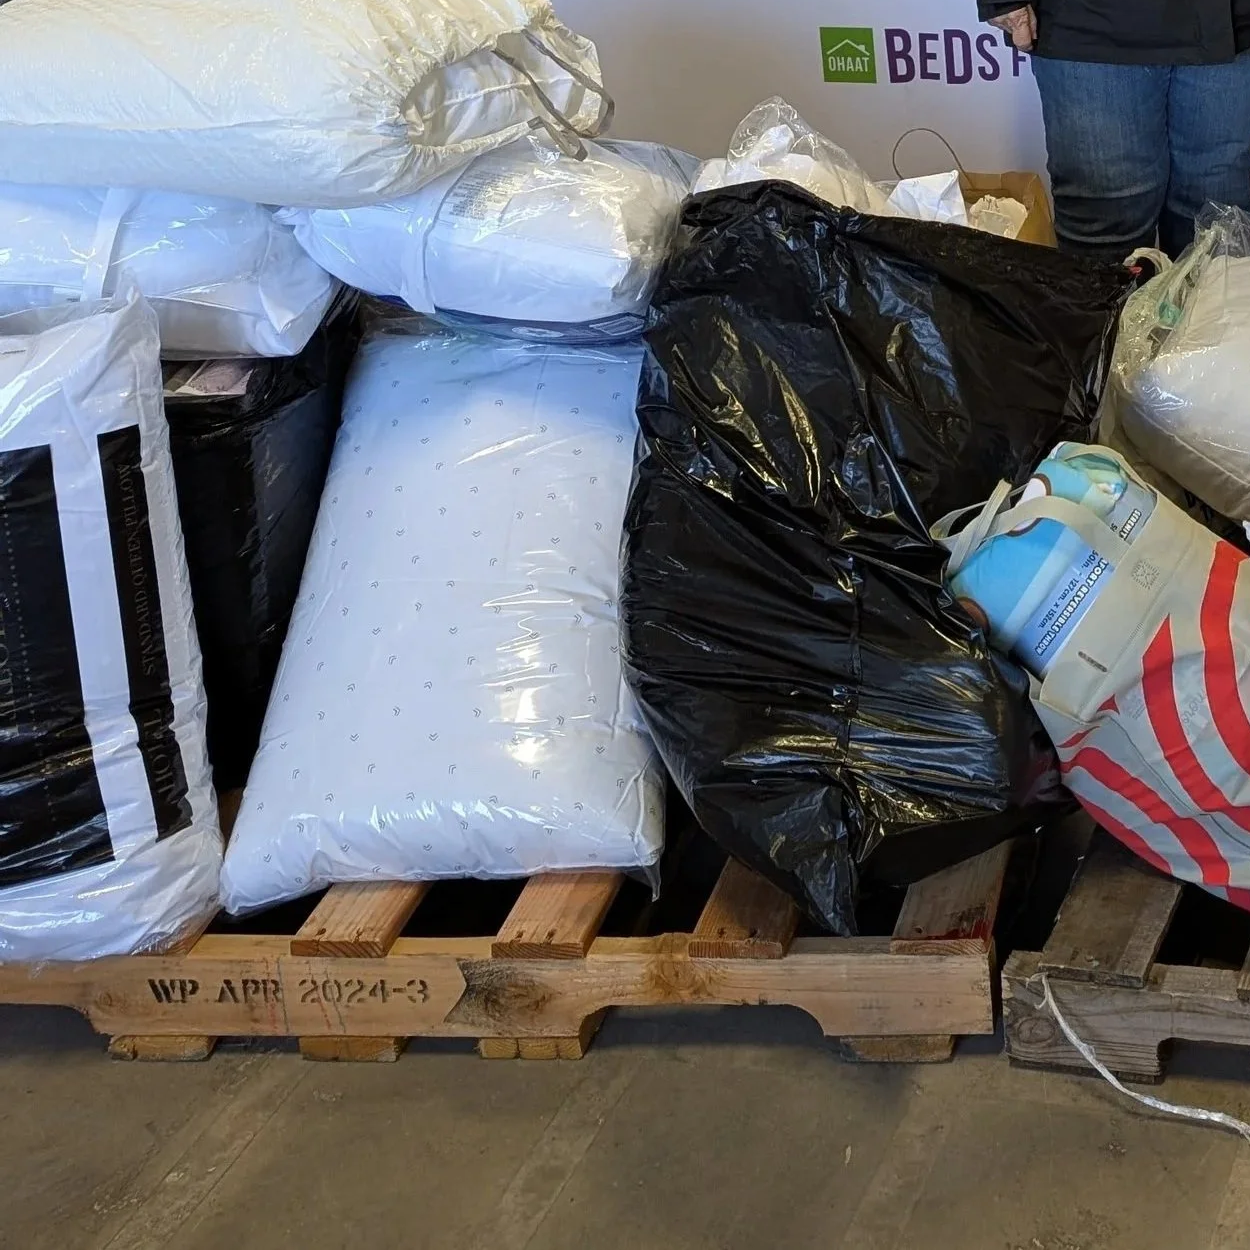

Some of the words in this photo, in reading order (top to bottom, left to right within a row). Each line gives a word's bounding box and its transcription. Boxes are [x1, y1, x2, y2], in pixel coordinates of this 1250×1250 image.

[829, 57, 868, 71] OHAAT
[885, 28, 1000, 85] BEDS
[1050, 584, 1090, 634] REVERSIBLE
[147, 978, 199, 1004] WP
[214, 978, 283, 1004] APR
[298, 978, 430, 1004] 2024-3
